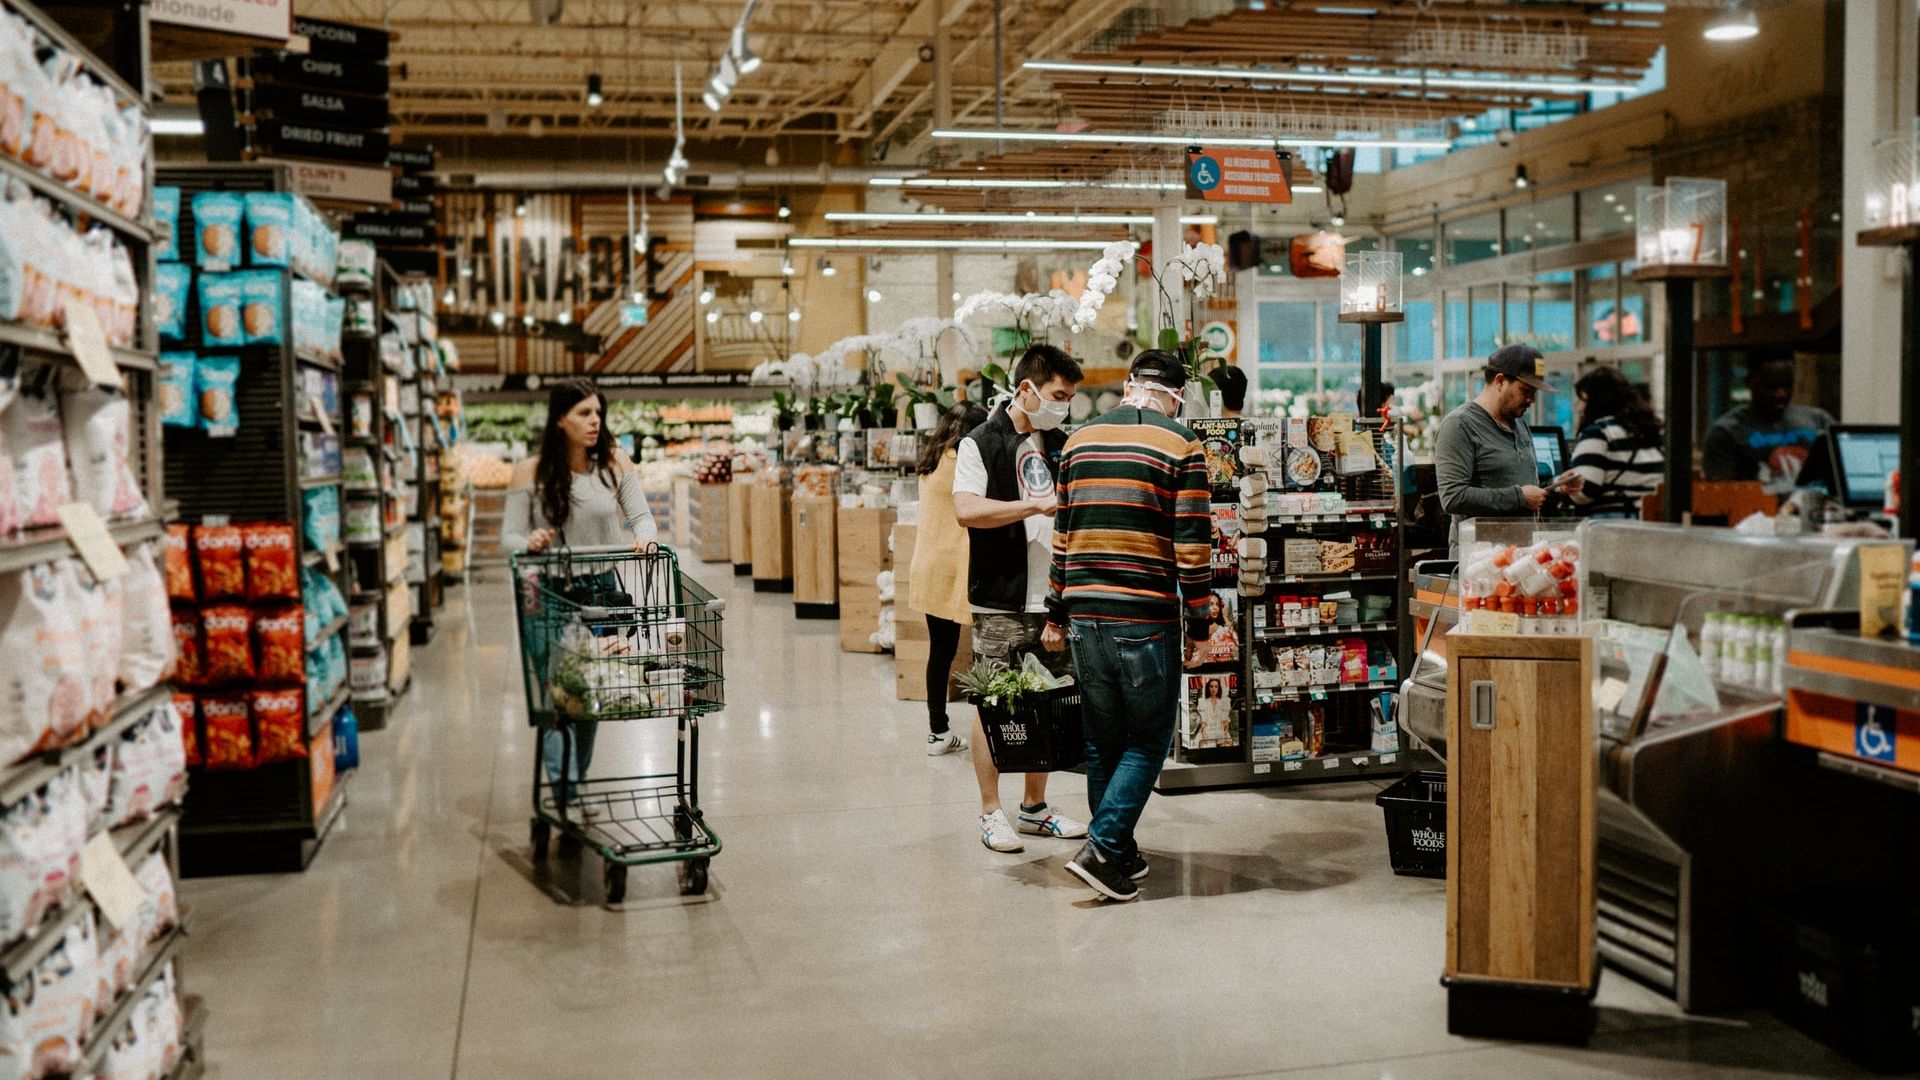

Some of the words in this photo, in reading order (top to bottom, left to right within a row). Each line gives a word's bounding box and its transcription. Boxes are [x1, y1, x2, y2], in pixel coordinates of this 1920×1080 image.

[297, 22, 357, 43] OPCORN
[302, 59, 343, 77] CHIPS
[302, 93, 344, 111] SALSA
[281, 125, 324, 143] DRIED
[326, 131, 364, 147] FRUIT
[1690, 223, 1704, 262] 7
[1193, 422, 1238, 430] PLANT-BASED
[197, 535, 242, 551] dang
[246, 533, 291, 549] dang
[204, 615, 248, 632] dang
[256, 616, 299, 634] dang
[203, 700, 248, 718] dang
[253, 696, 298, 713] dang
[1000, 723, 1026, 732] WHOLE
[1002, 732, 1027, 741] FOODS
[1411, 828, 1446, 840] WHOLE
[1413, 838, 1445, 849] FOODS
